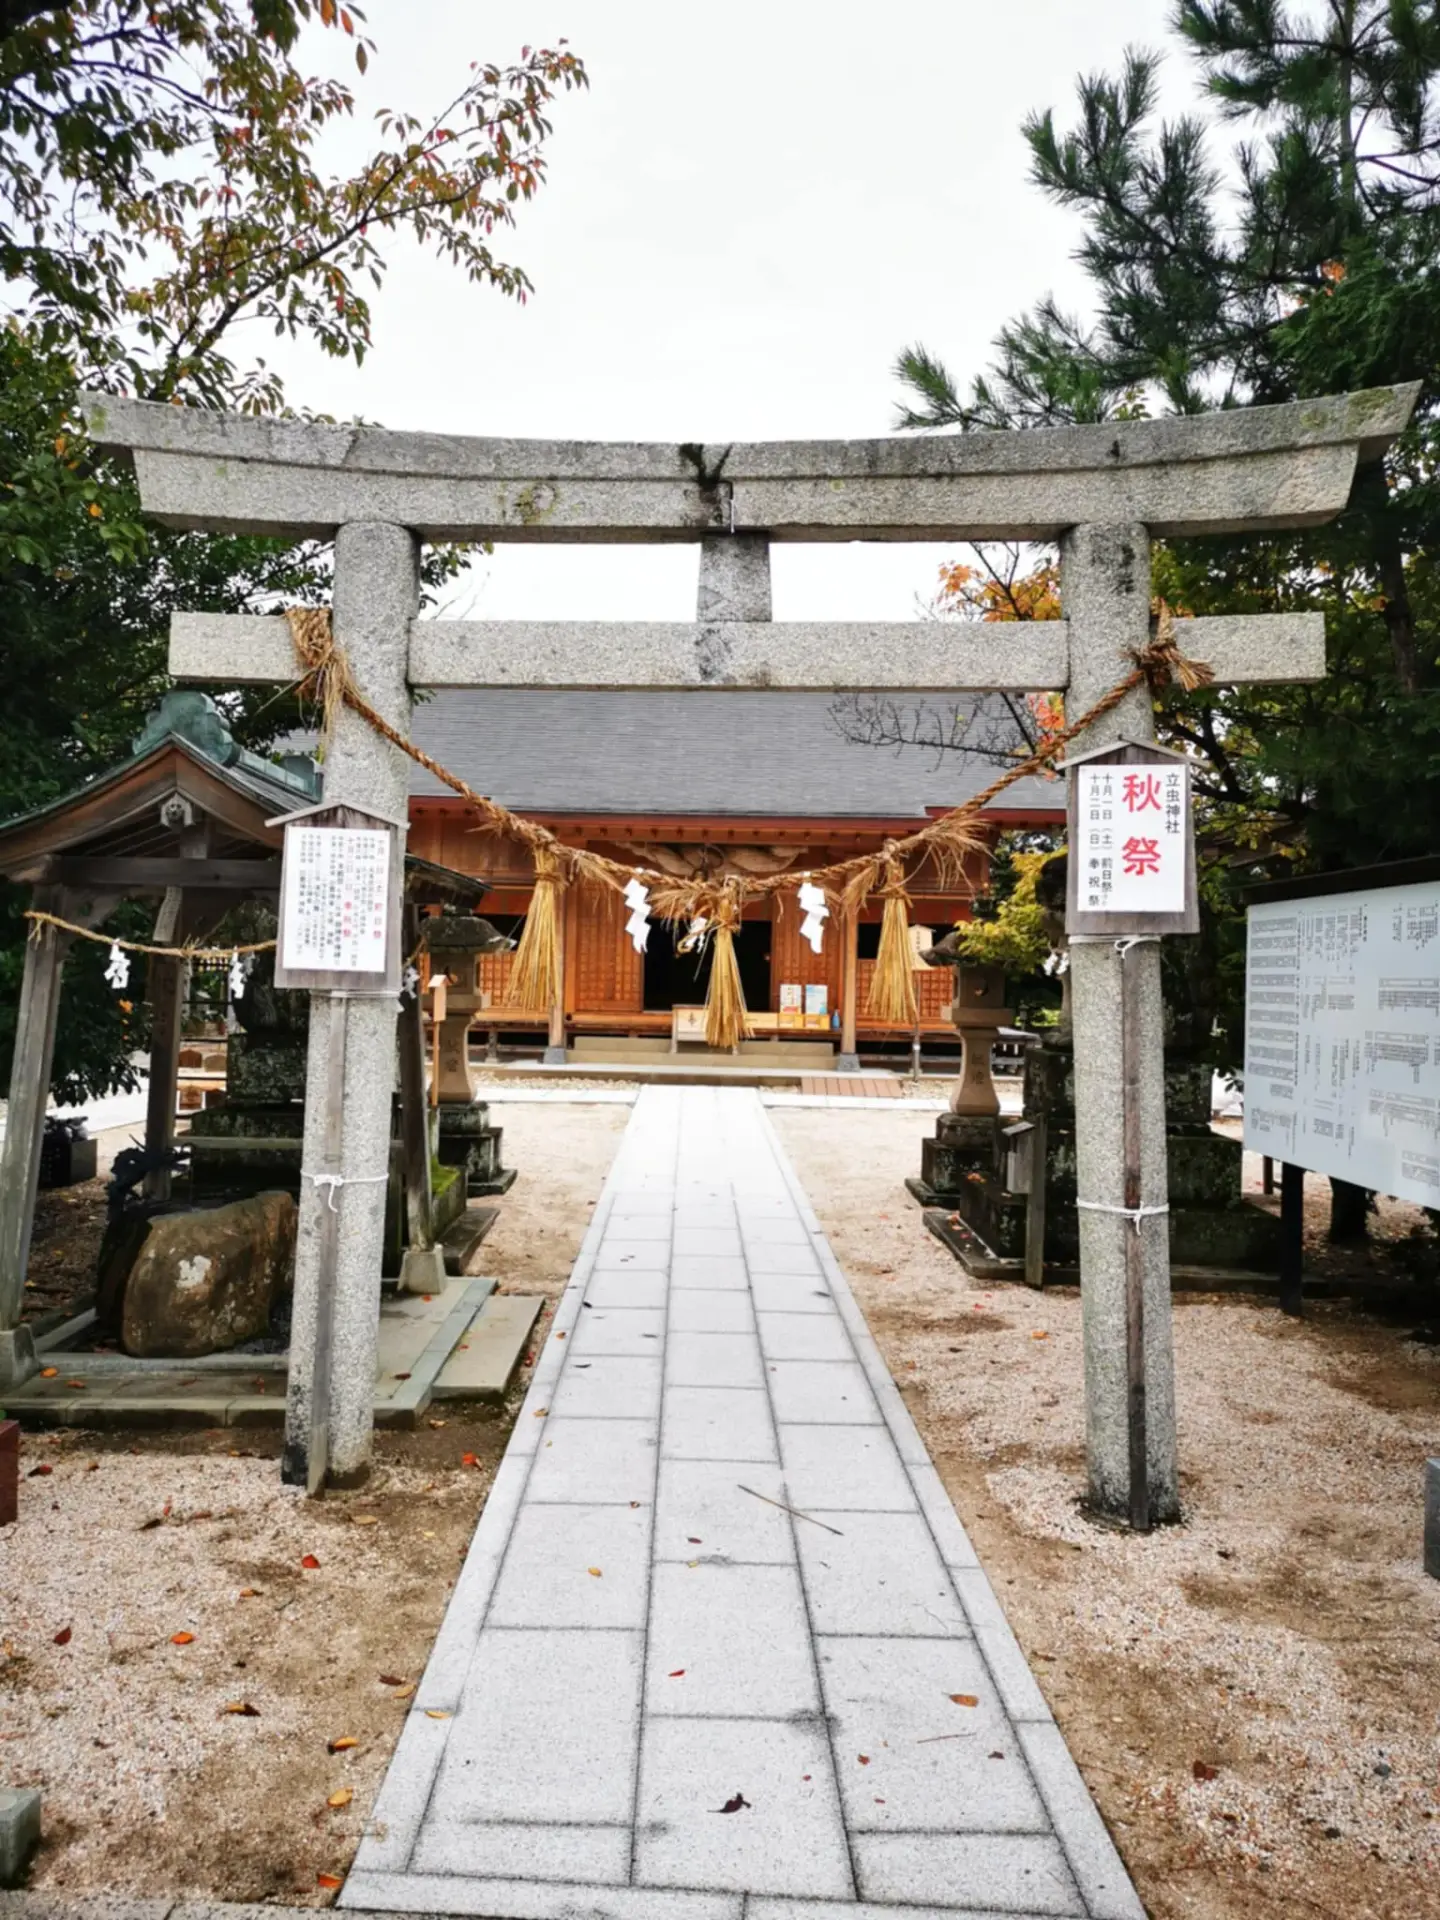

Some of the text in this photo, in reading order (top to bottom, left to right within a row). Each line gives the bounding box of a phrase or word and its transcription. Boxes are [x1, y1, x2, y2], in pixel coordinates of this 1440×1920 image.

[1122, 773, 1162, 876] 秋祭
[1165, 773, 1181, 834] 立虫神社
